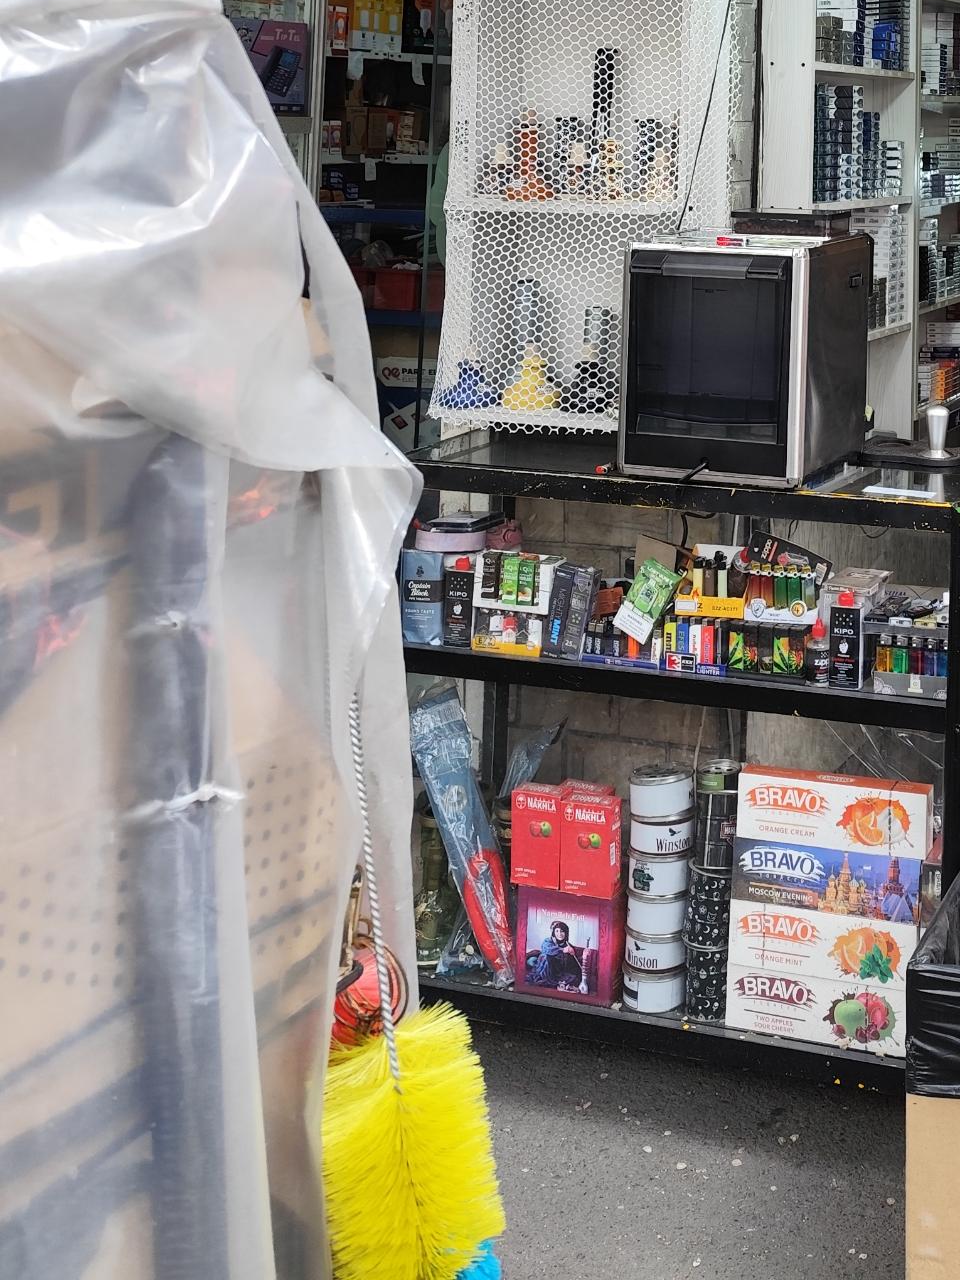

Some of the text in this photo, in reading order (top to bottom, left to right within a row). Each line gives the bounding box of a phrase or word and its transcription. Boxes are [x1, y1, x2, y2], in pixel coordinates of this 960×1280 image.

[760, 538, 773, 560] zippo
[407, 580, 431, 590] Captain
[409, 588, 430, 597] Black
[448, 590, 468, 598] KIPO
[833, 627, 854, 635] KIPO
[697, 668, 720, 676] LIGHTER
[527, 796, 557, 812] NAKHLA
[755, 787, 821, 812] BRAVO
[575, 808, 606, 823] NAKHLA
[758, 824, 815, 838] ORANGE CREAM
[656, 835, 691, 852] Winston
[750, 851, 815, 875] BRAVO
[748, 886, 814, 903] MOSCOW EVENING
[747, 915, 812, 941] BRAVO
[754, 953, 803, 967] ORANGE MINT
[743, 977, 808, 1005] BRAVO
[755, 1015, 794, 1026] TWO APPLES
[754, 1022, 794, 1034] SOUR CHERRY
